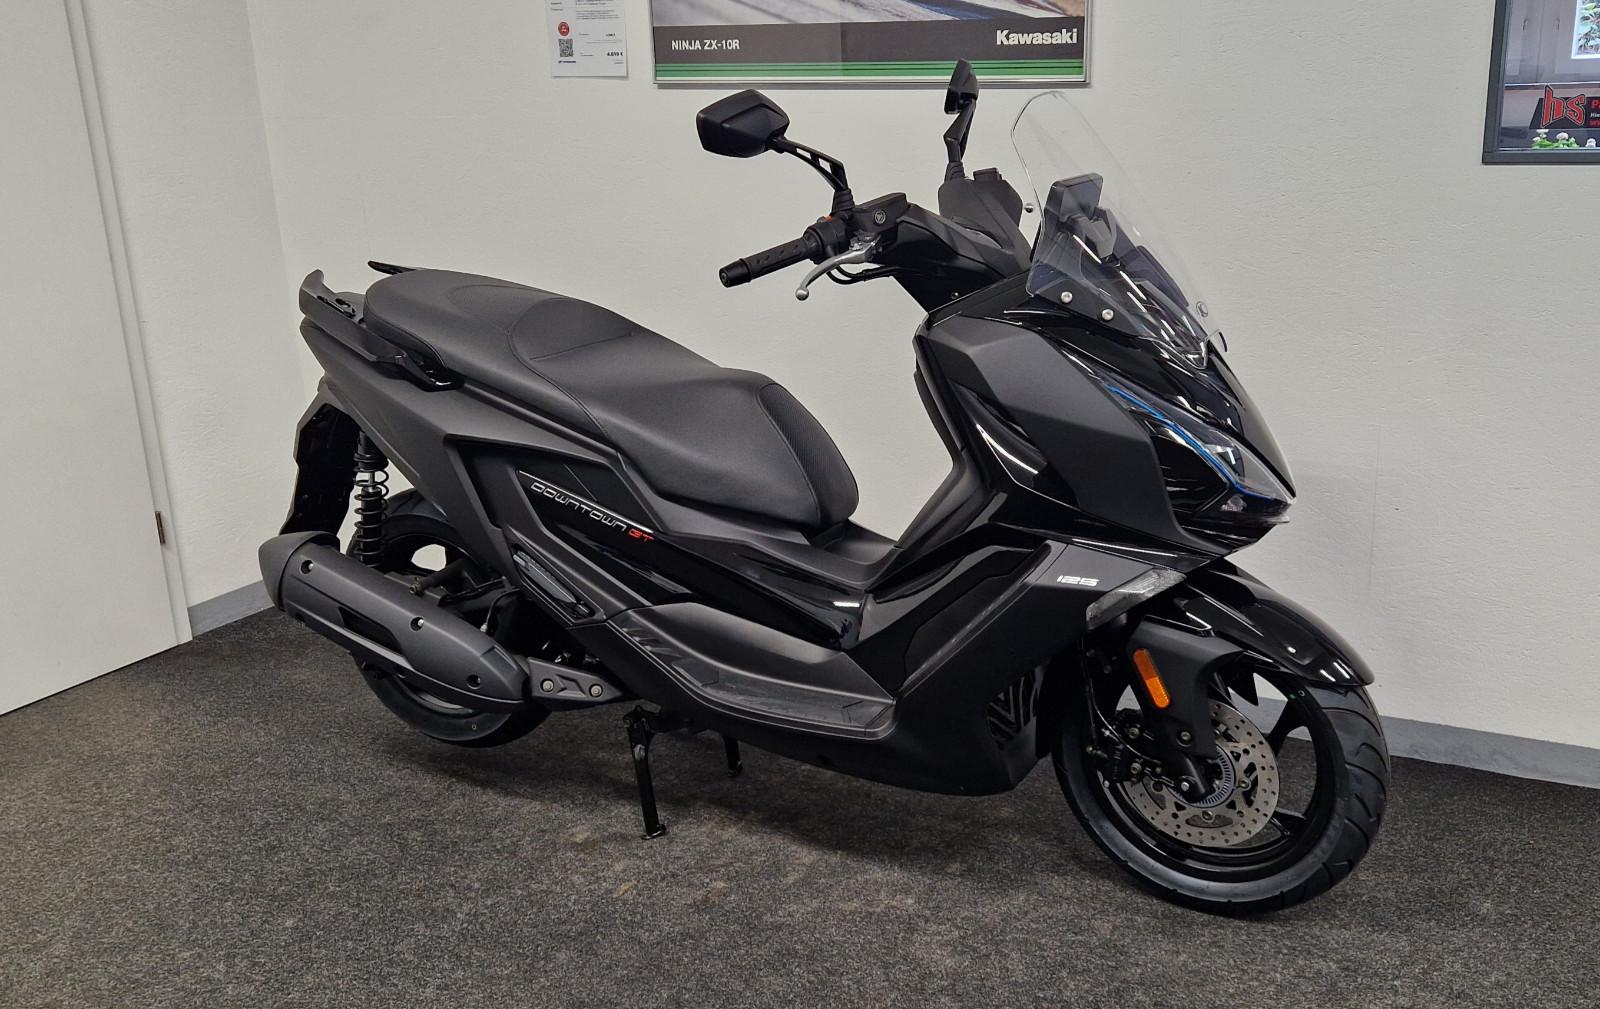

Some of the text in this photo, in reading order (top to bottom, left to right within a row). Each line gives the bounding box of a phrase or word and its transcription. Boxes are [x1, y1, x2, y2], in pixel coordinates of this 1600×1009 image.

[996, 28, 1077, 45] Kawasaki
[671, 39, 740, 50] NINJA ZX-10R
[628, 528, 655, 542] GT
[1056, 575, 1100, 587] 125
